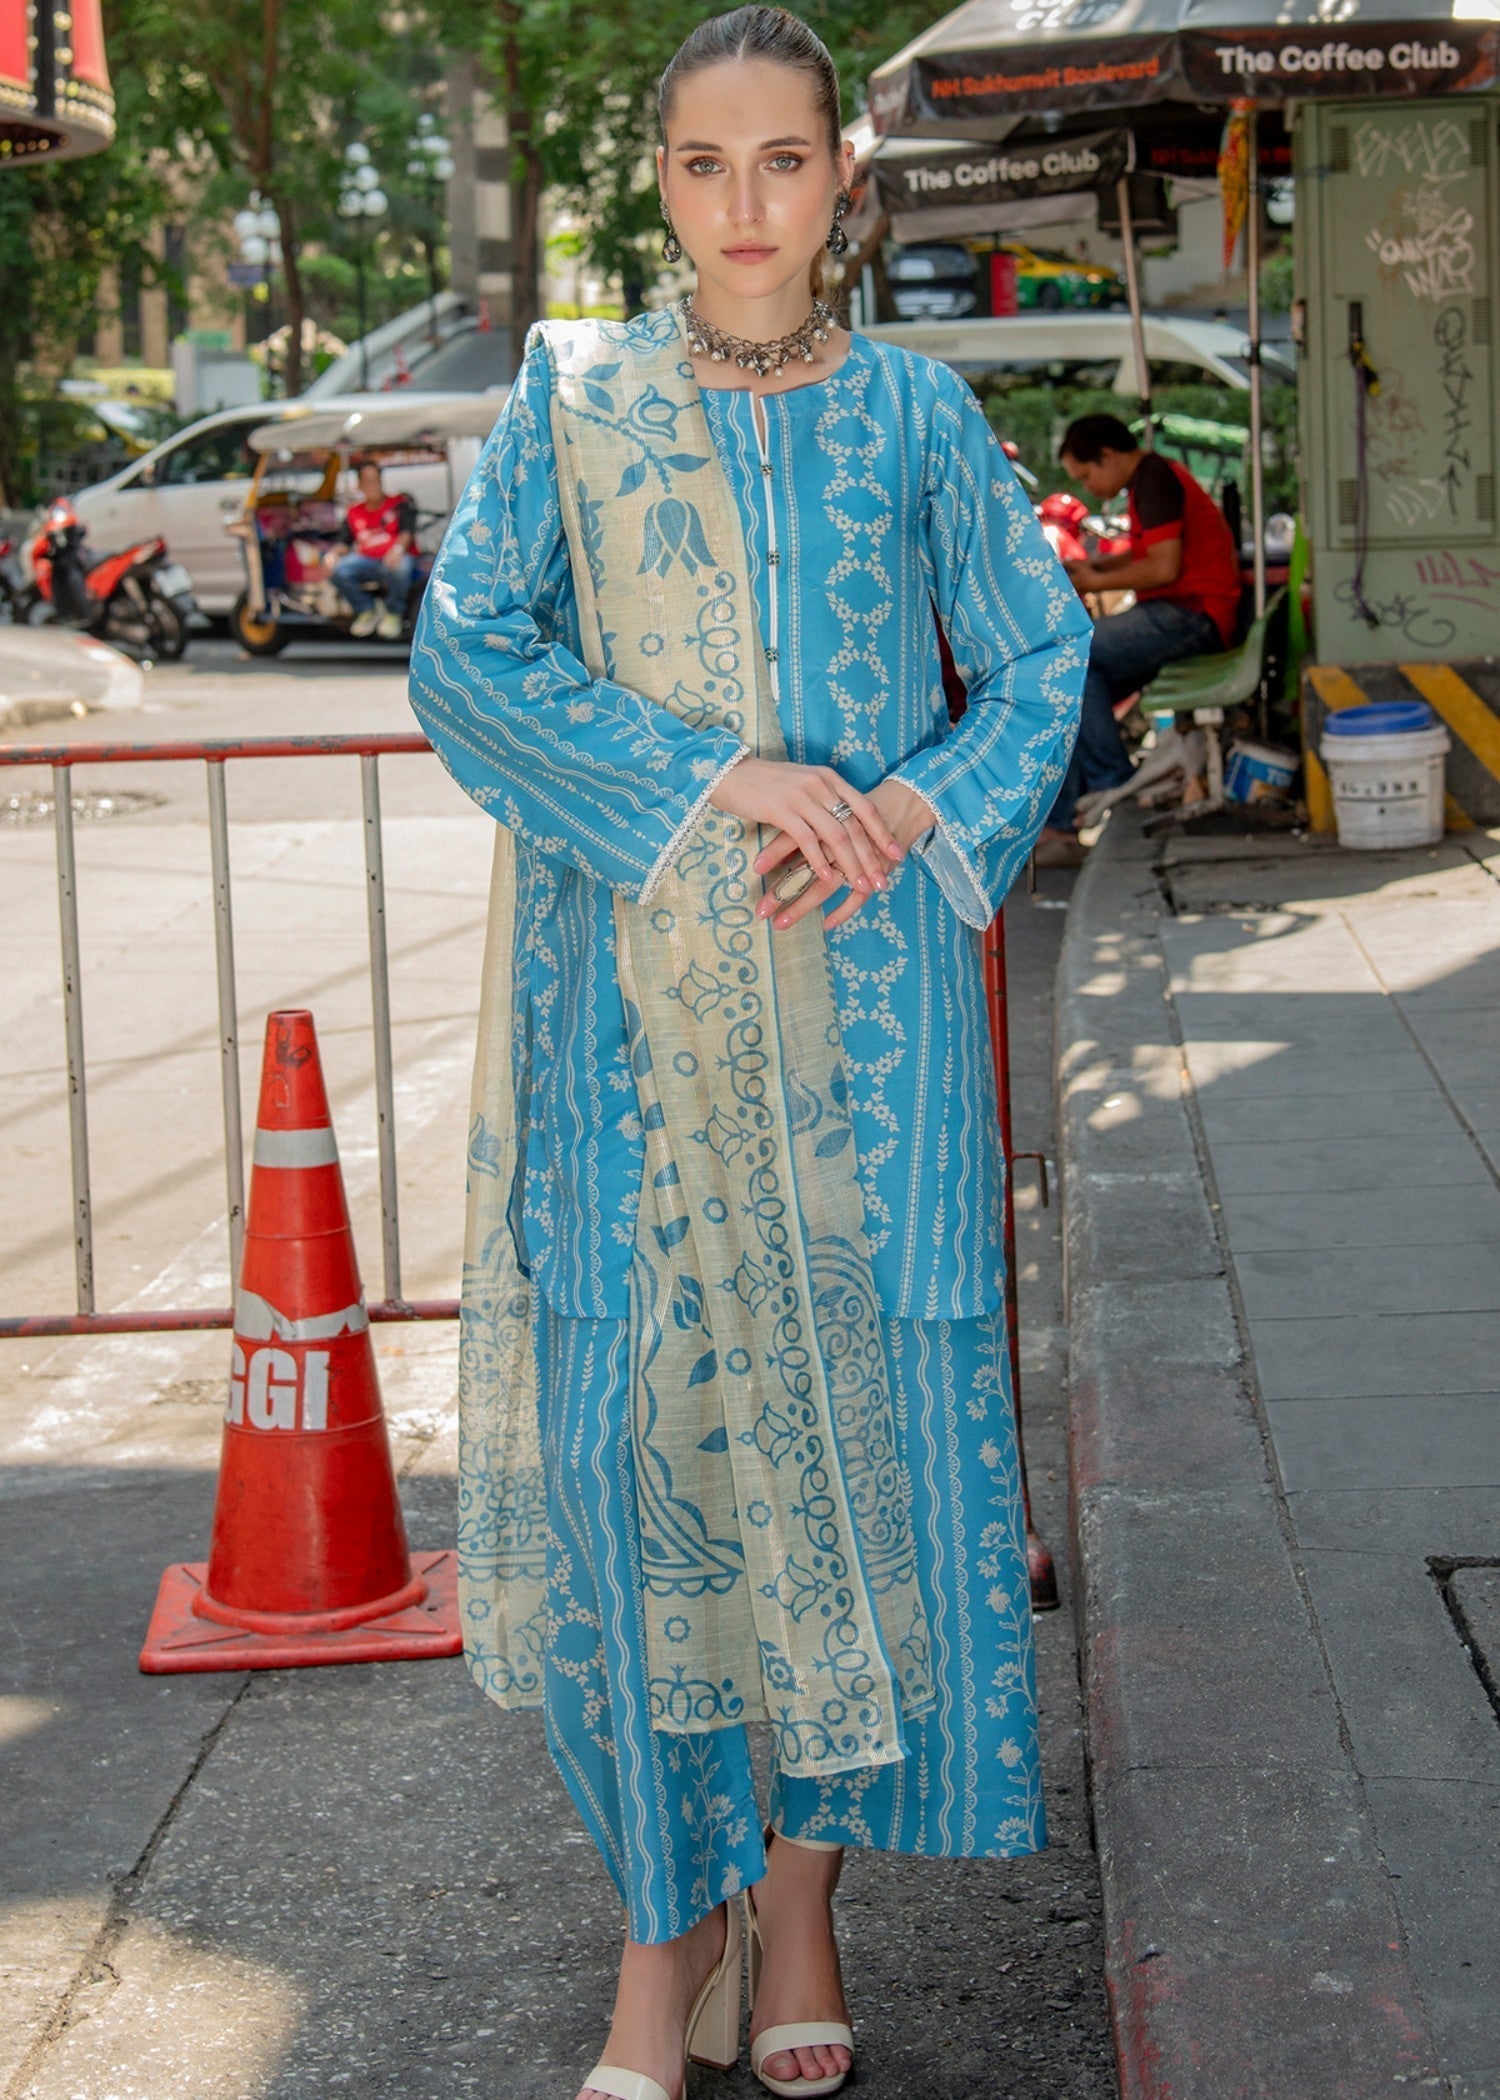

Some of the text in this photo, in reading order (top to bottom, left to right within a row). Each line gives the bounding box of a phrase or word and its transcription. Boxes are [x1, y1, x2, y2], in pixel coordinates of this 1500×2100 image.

[1215, 41, 1460, 74] The Coffee Club
[904, 148, 1100, 192] The Coffee Club
